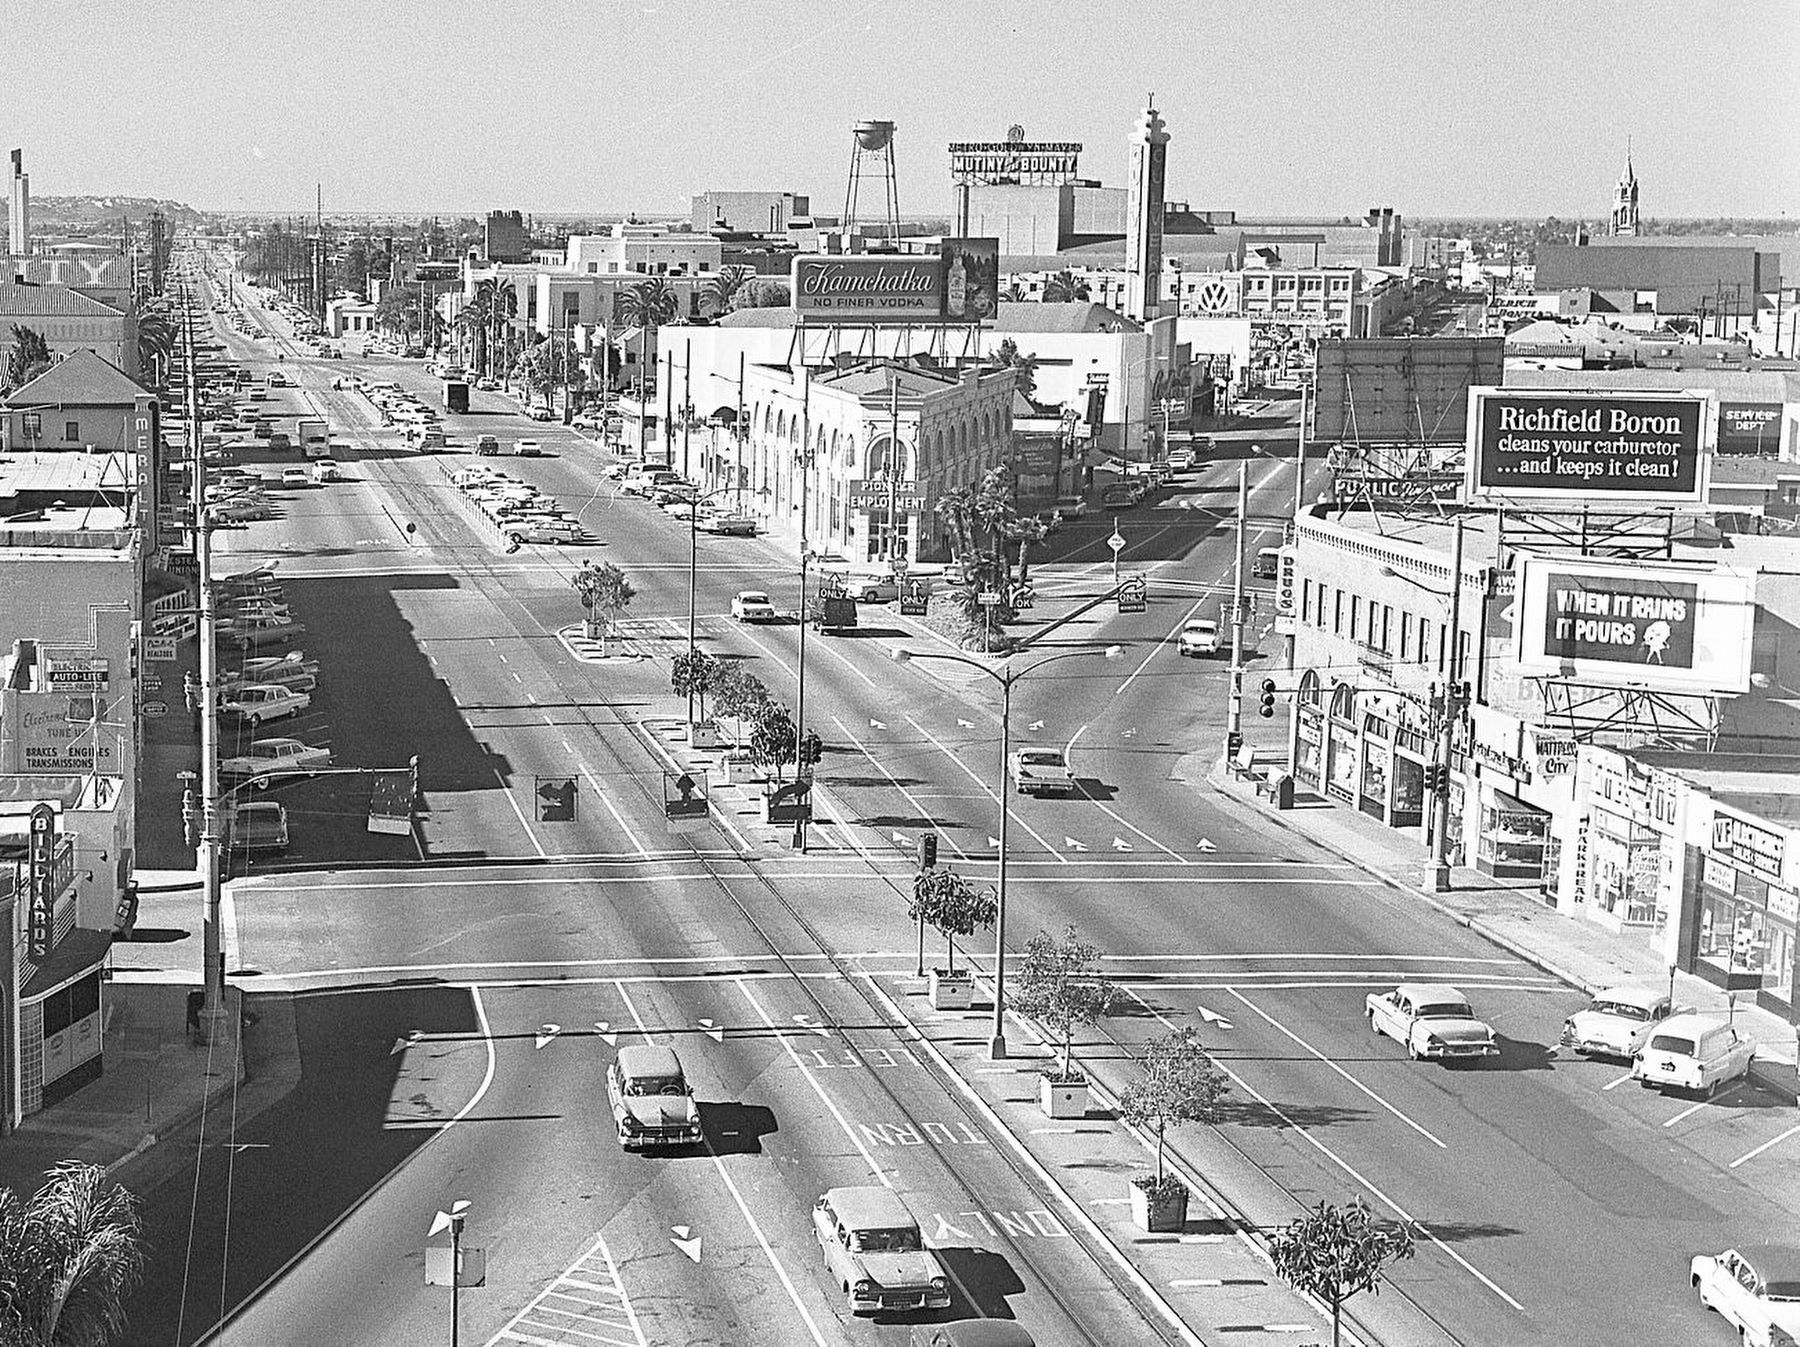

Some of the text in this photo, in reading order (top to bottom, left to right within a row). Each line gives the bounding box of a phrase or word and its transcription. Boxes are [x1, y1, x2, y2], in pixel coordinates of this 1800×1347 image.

[953, 156, 1003, 171] MUTINY
[1021, 156, 1076, 171] BOUNTY
[0, 259, 113, 285] ITY
[804, 263, 935, 295] Kamchatka
[813, 298, 925, 307] NO FINER VODKA
[1500, 407, 1683, 435] Richfield Boron
[1726, 410, 1776, 421] SERVICE
[1498, 434, 1680, 457] cleans your carburetor
[1556, 457, 1604, 480] keeps
[1608, 460, 1622, 476] it
[1625, 461, 1679, 478] clean!
[861, 481, 916, 492] PIONER
[1335, 480, 1399, 496] PUBLIC
[851, 496, 926, 509] EMPLOMENT
[1280, 556, 1295, 609] DRUGS
[821, 588, 846, 598] ONLY
[902, 595, 927, 605] ONLY
[1119, 593, 1144, 602] ONLY
[1016, 599, 1031, 608] OK
[1556, 589, 1687, 622] WHEN IT RAINS
[1555, 617, 1637, 645] IT POURS
[47, 729, 72, 738] TUNE
[26, 748, 58, 758] BRAKES
[27, 759, 94, 769] TRANSMISSIONS
[33, 817, 49, 957] BILLIARDS
[811, 1049, 921, 1068] LEFT
[858, 1122, 988, 1145] TURN
[932, 1211, 1068, 1240] ONLY
